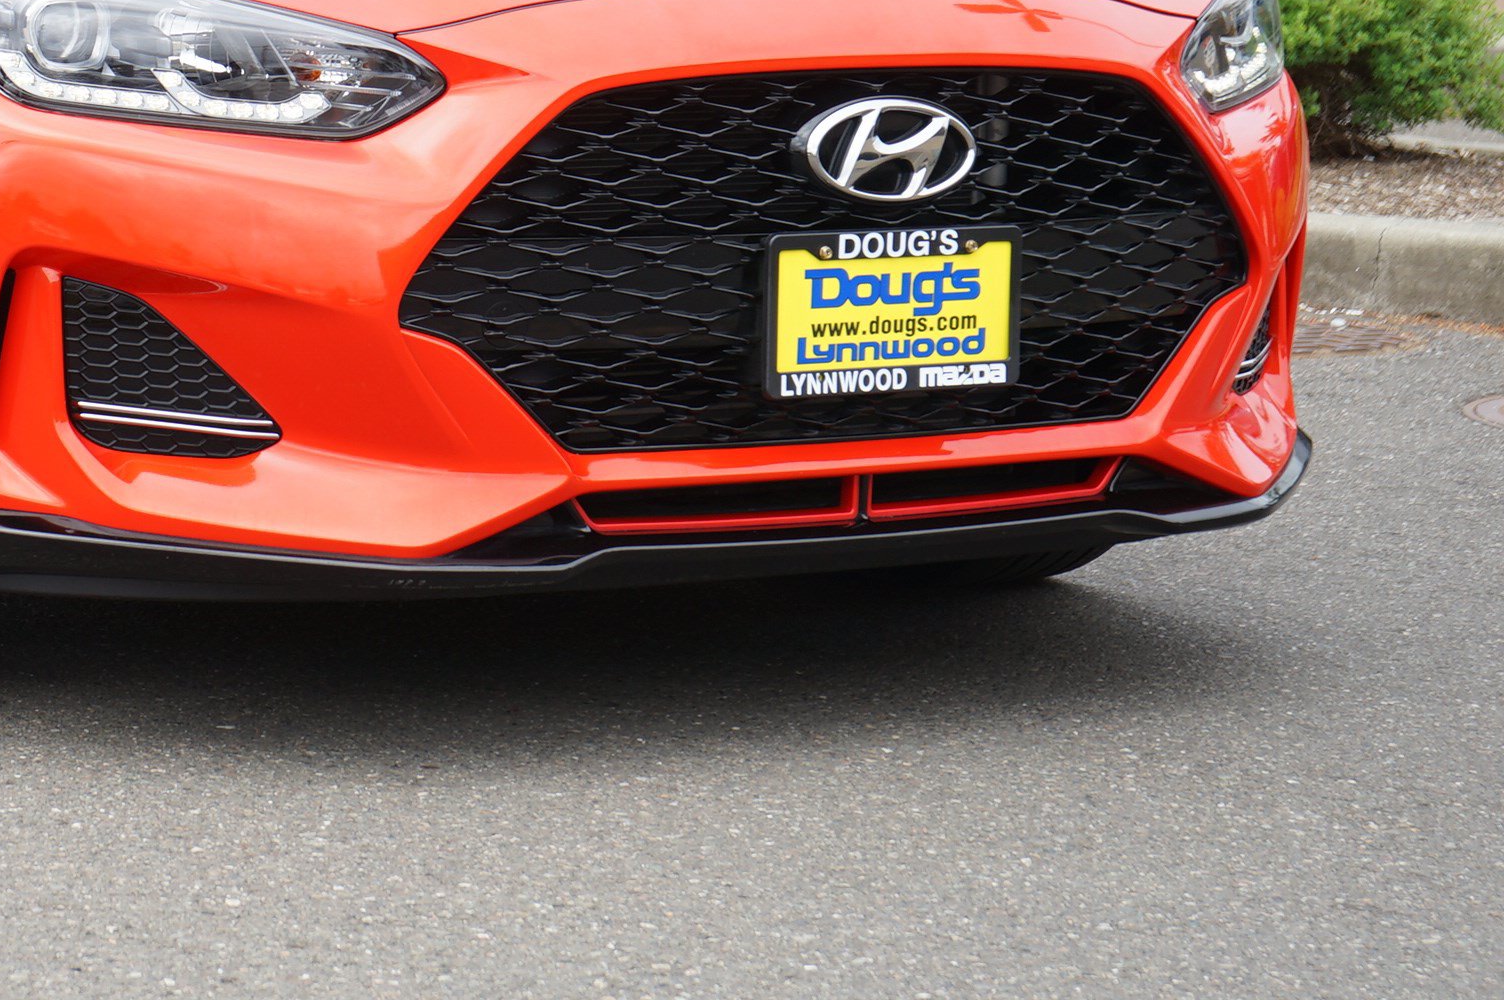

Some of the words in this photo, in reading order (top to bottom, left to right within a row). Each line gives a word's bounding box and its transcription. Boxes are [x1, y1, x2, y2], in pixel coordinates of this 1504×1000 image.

[838, 229, 959, 259] DOUG'S
[804, 262, 981, 316] Doug's
[811, 314, 977, 337] www.dougs.com
[796, 328, 986, 364] Lynnwood
[780, 368, 907, 397] LYNNWOOD
